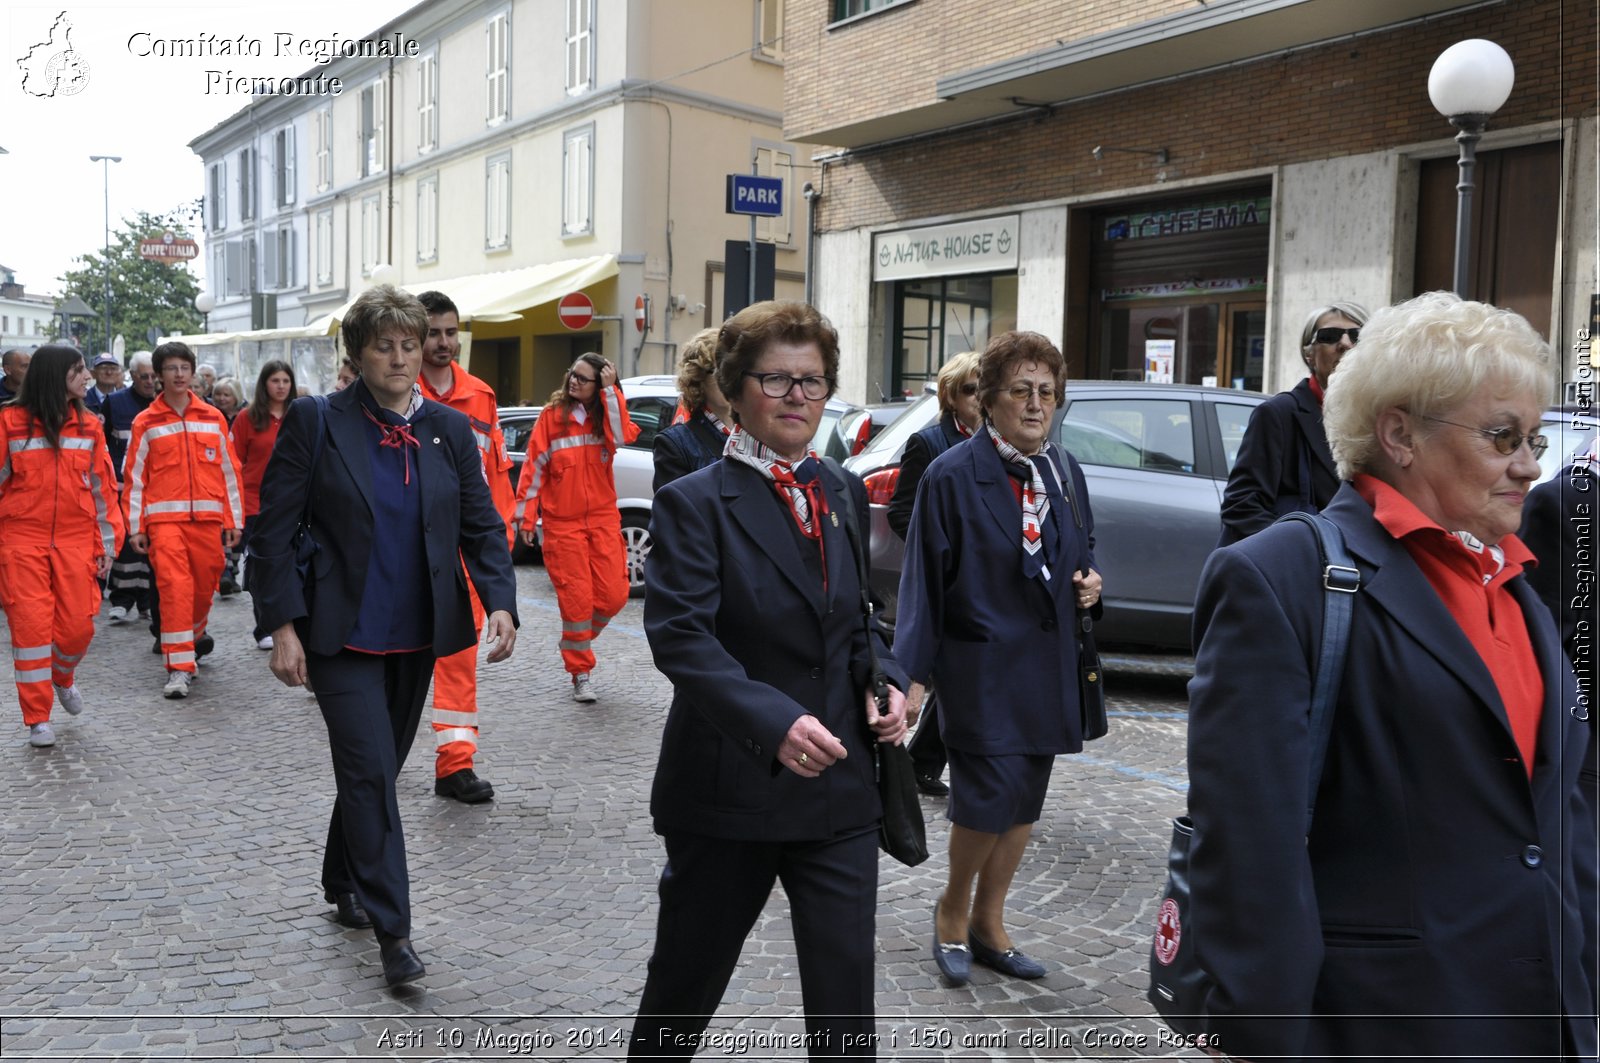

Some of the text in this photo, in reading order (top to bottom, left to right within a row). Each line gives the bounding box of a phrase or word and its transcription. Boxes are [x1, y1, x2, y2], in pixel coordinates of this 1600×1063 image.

[738, 186, 778, 204] PARK
[1138, 203, 1260, 238] CHEEMA
[893, 232, 994, 265] NATUR HOUSE
